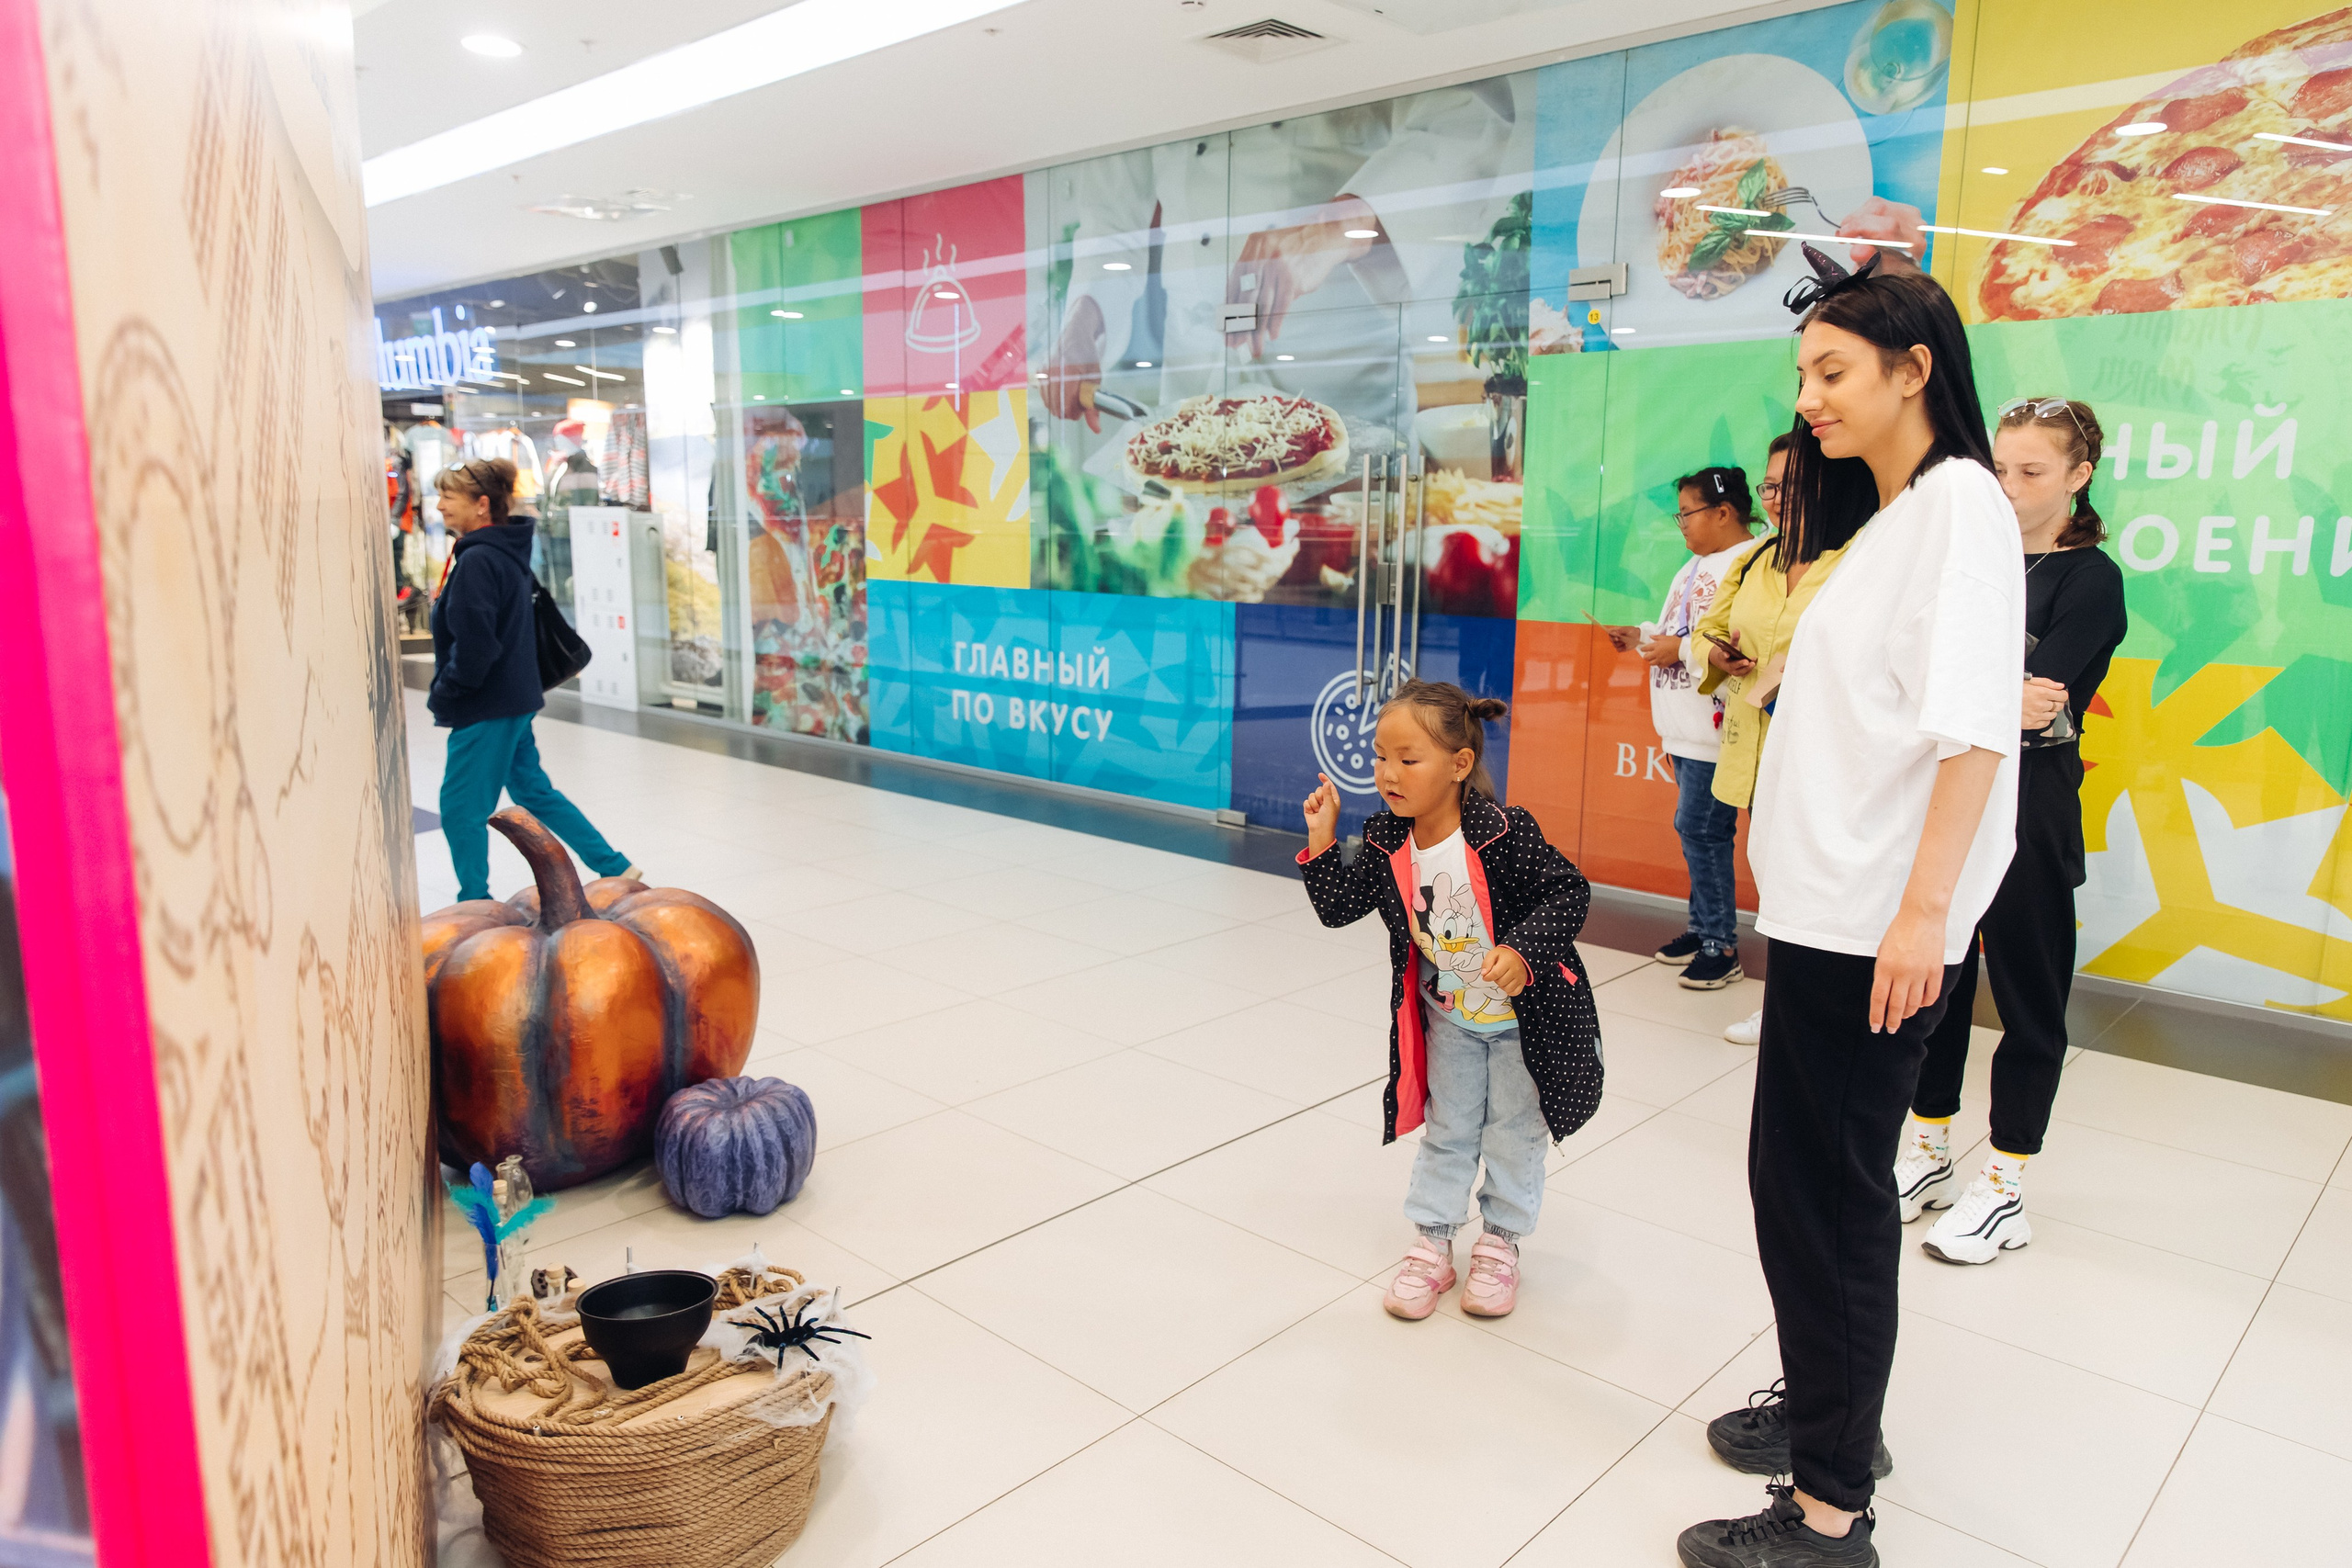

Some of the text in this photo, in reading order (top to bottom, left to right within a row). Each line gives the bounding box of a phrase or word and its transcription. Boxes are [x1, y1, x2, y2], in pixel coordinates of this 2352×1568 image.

[1589, 313, 1600, 321] 13
[954, 640, 1110, 691] ГЛАВНЫЙ
[952, 689, 1114, 742] ПО ВКУСУ
